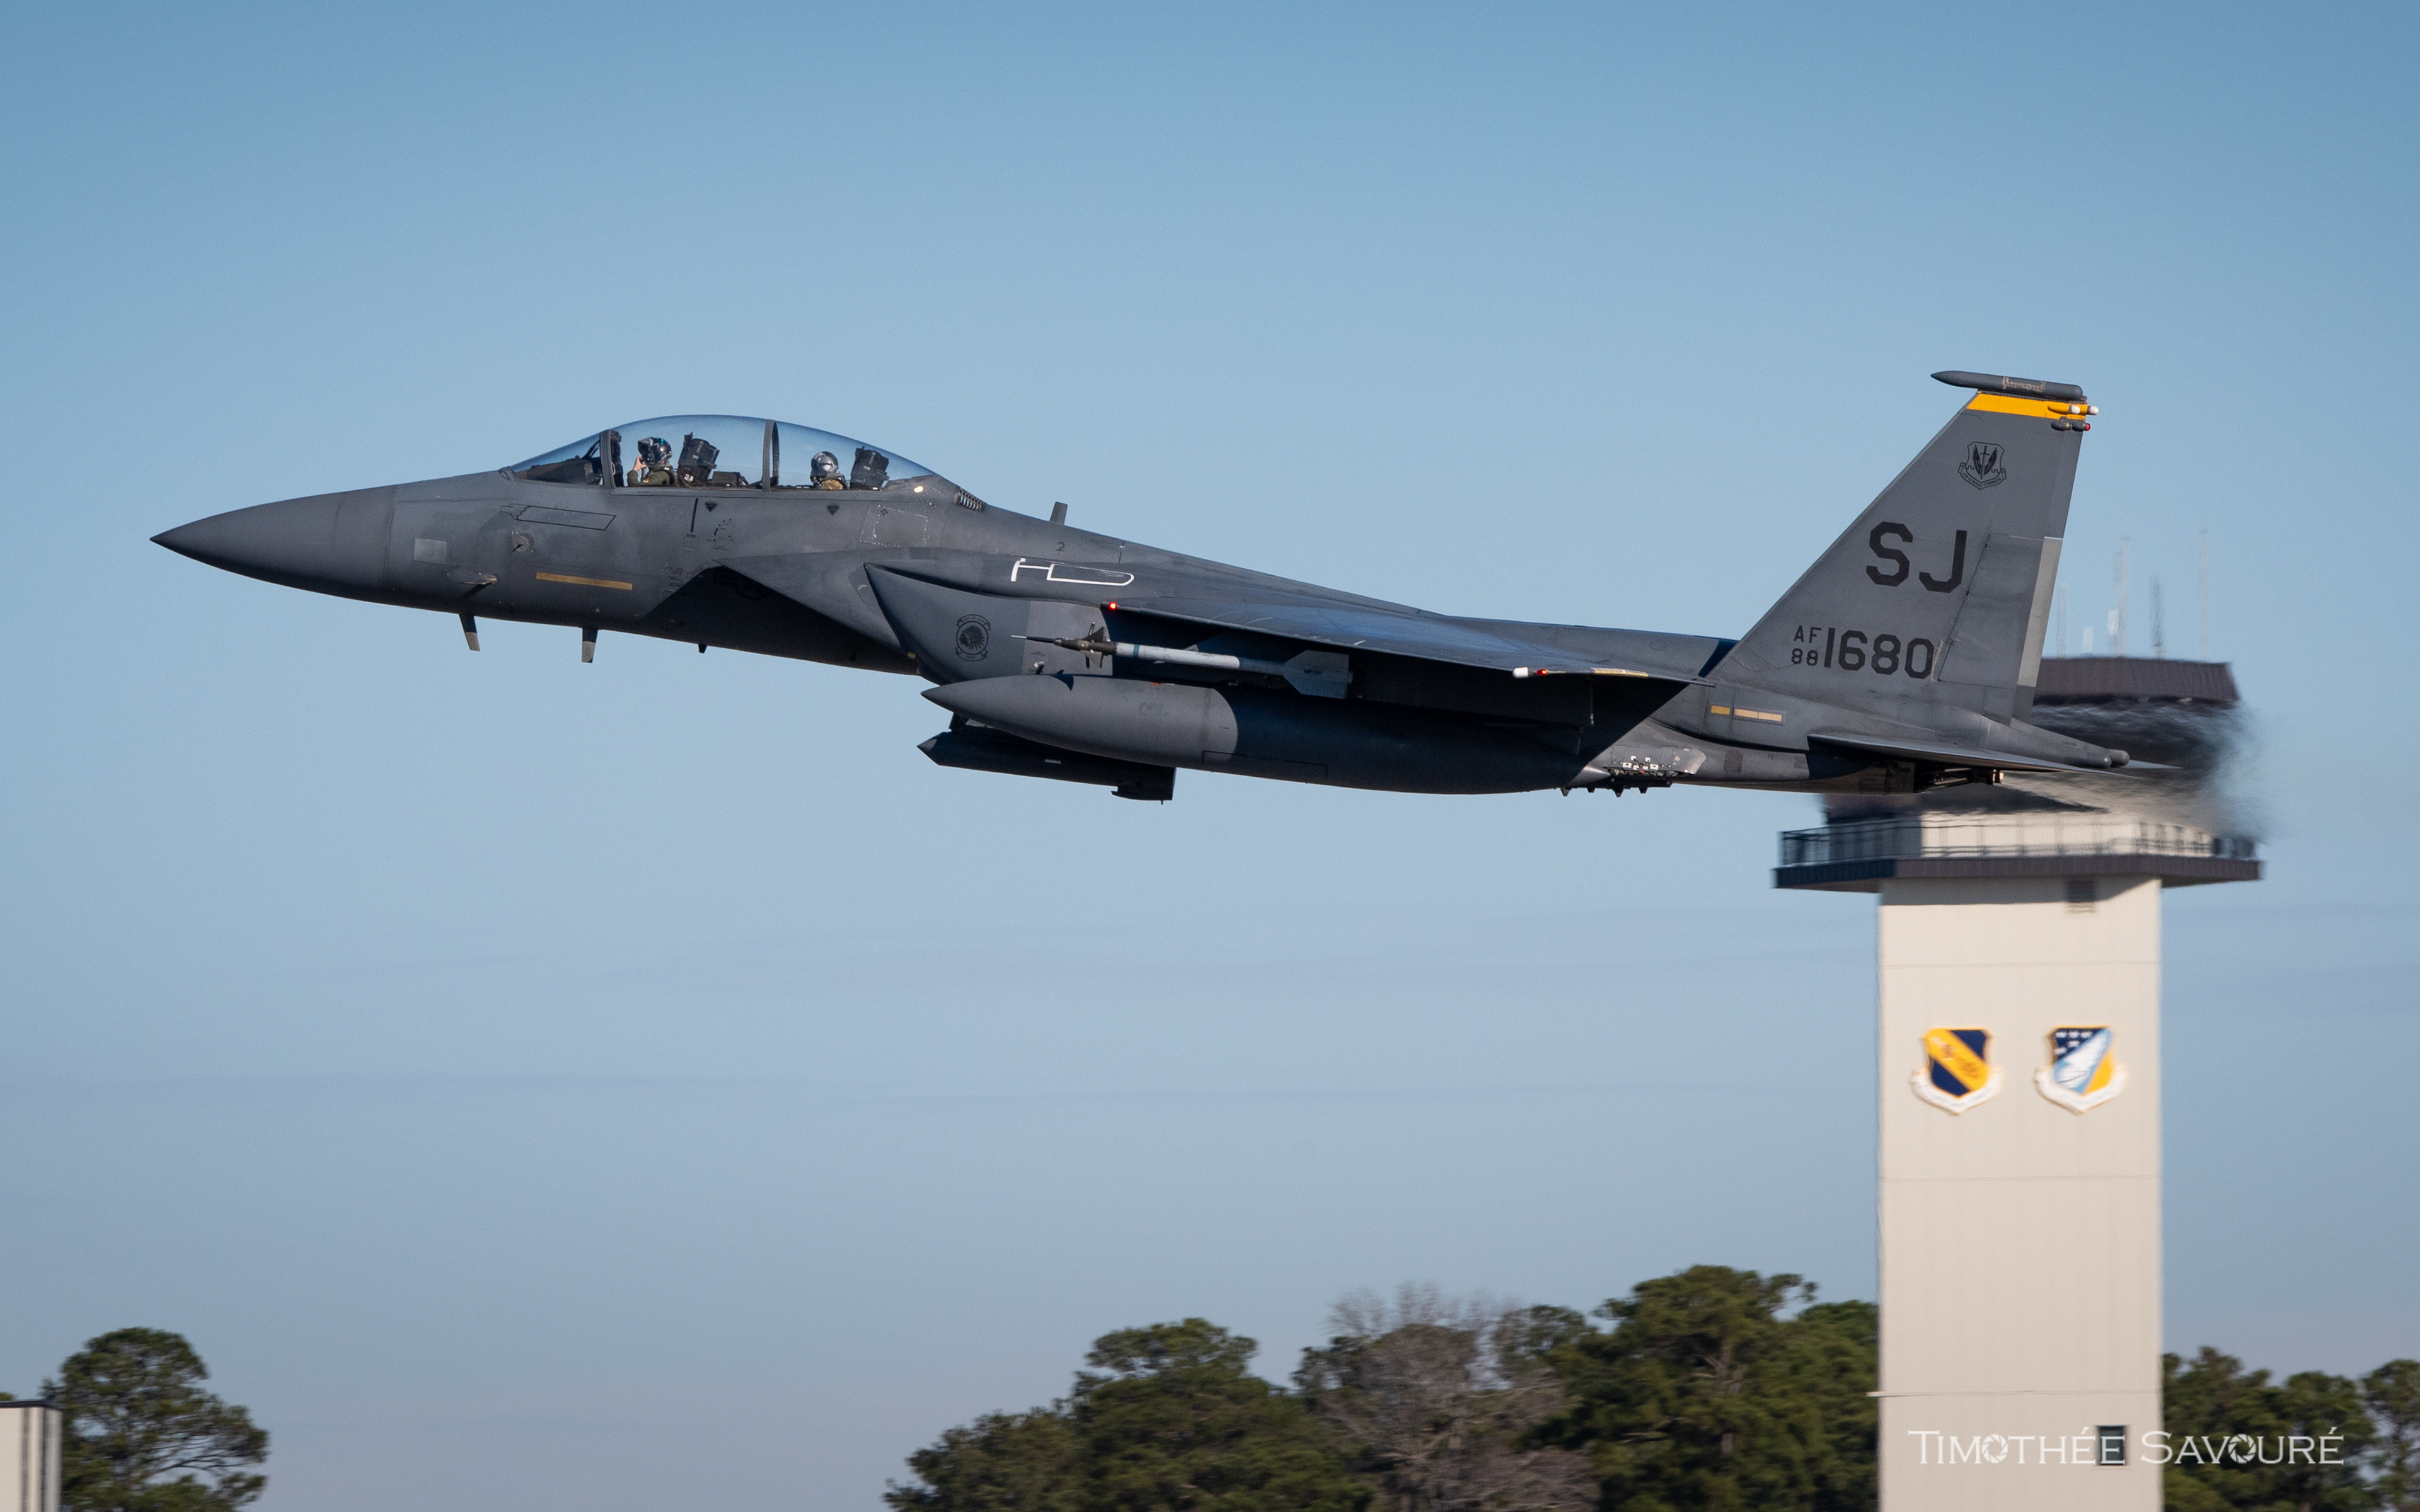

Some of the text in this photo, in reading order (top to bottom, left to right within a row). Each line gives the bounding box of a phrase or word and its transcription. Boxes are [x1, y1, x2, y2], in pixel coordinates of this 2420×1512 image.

[1865, 521, 1968, 593] SJ
[1791, 627, 1934, 679] 88 1680
[1794, 625, 1822, 643] AF
